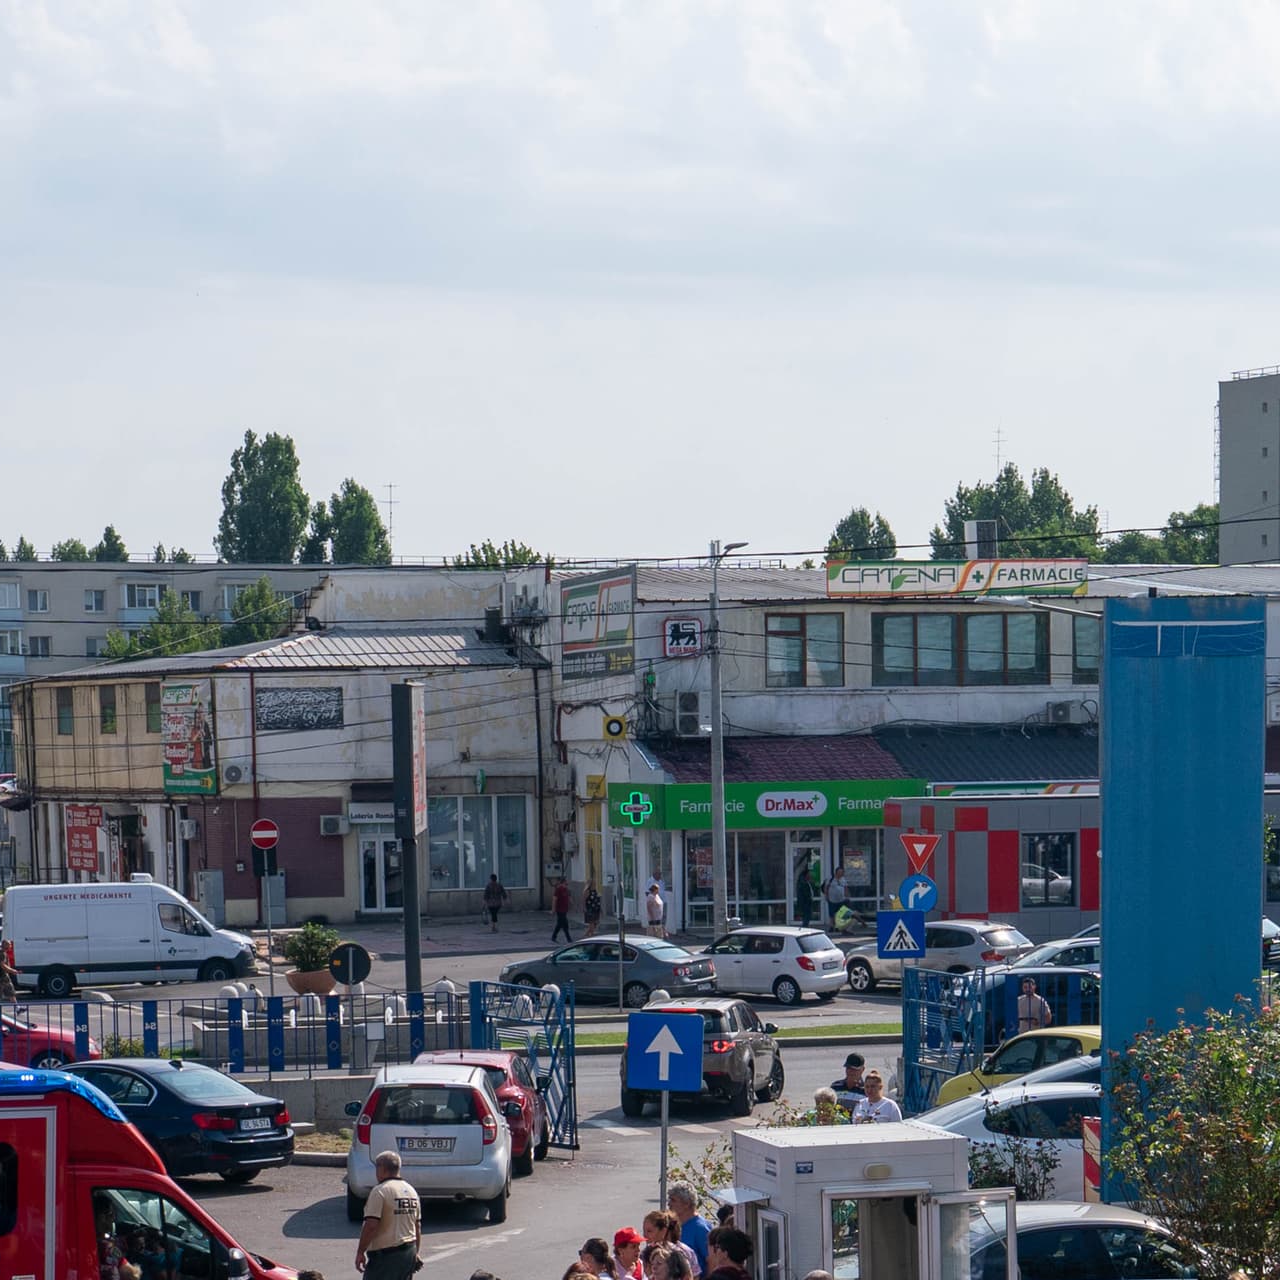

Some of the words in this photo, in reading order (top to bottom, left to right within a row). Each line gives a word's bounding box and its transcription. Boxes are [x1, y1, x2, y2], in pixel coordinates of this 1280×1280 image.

[842, 567, 956, 588] CATENA
[997, 567, 1084, 581] FARMACIE
[680, 800, 745, 813] Farmcie
[44, 893, 76, 901] URGENTE
[80, 892, 132, 900] MEDICAMENTE
[408, 1139, 414, 1148] B
